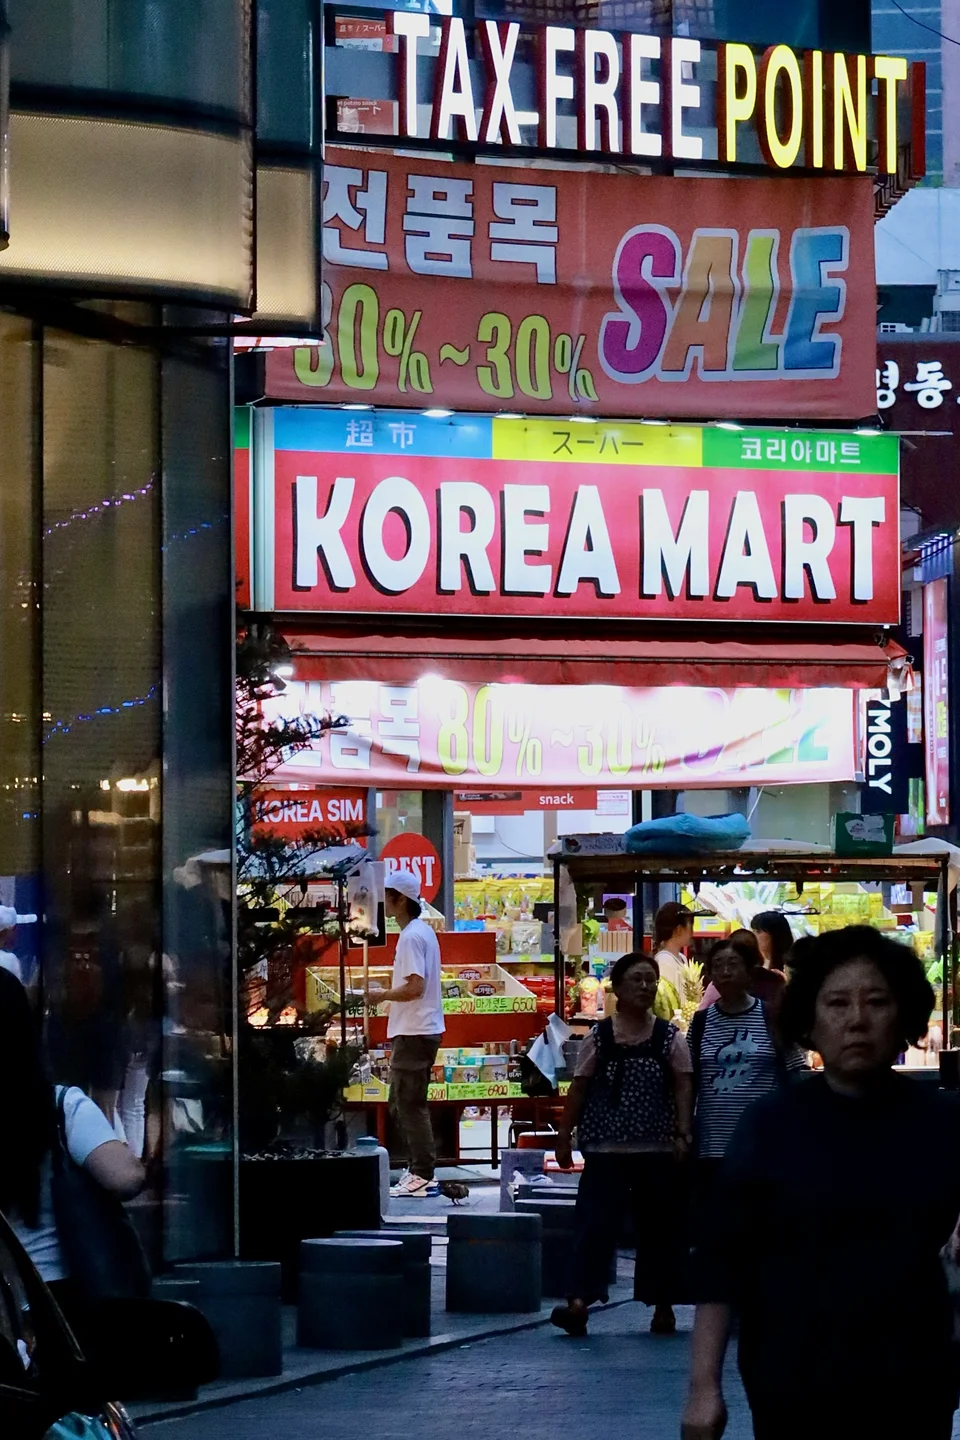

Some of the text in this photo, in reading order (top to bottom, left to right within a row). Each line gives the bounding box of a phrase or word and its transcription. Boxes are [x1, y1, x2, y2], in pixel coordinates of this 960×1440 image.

[724, 42, 908, 175] POINT
[323, 163, 851, 383] 전품목 SALE
[346, 419, 416, 448] 超市
[552, 431, 644, 456] スーパー
[741, 437, 862, 465] 코리아마트
[293, 475, 886, 601] KOREA MART
[254, 798, 363, 824] KOREA SIM
[539, 792, 574, 805] snack
[512, 996, 537, 1013] 6500
